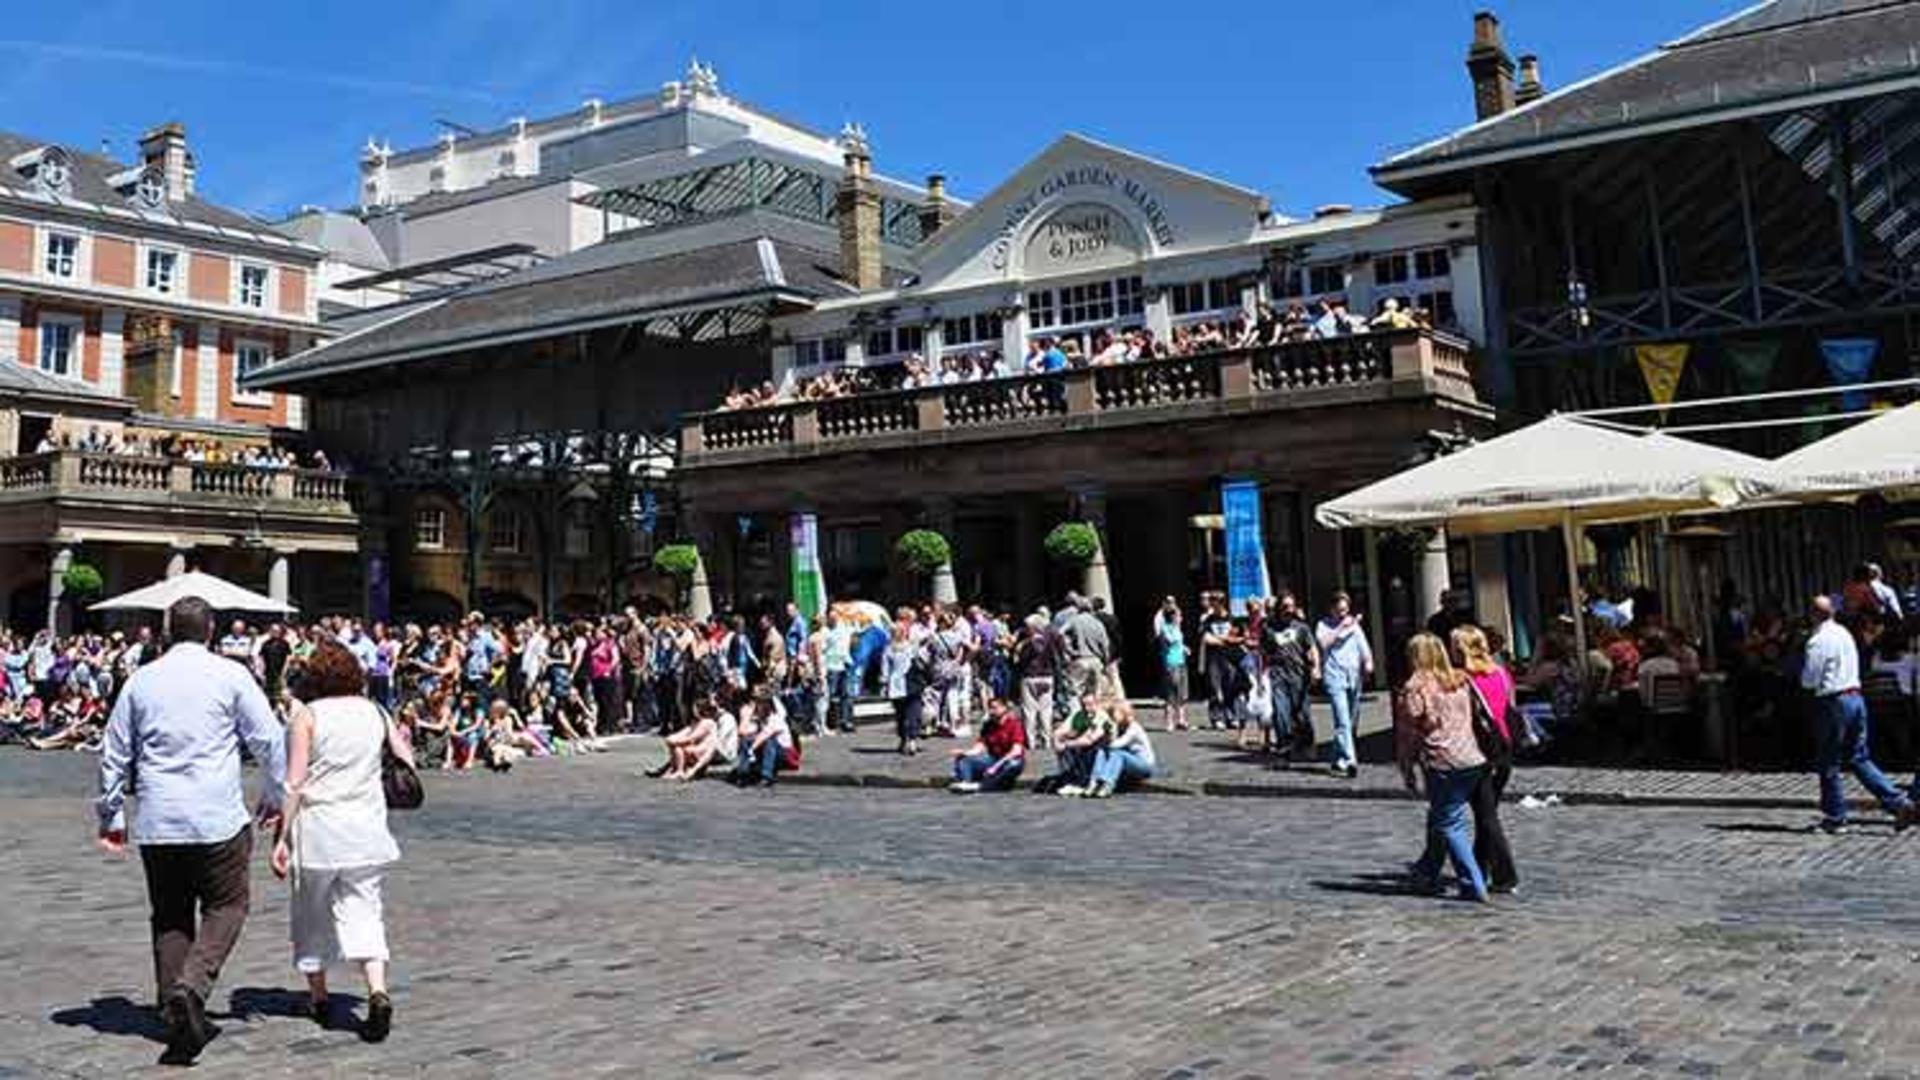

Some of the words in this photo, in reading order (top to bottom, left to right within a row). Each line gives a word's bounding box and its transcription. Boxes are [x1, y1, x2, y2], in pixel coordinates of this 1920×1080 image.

[1041, 167, 1119, 196] GARDEN
[1124, 178, 1175, 247] MARKET
[1048, 214, 1110, 237] PUNCH
[1049, 241, 1063, 259] &
[1068, 235, 1107, 256] JUDY
